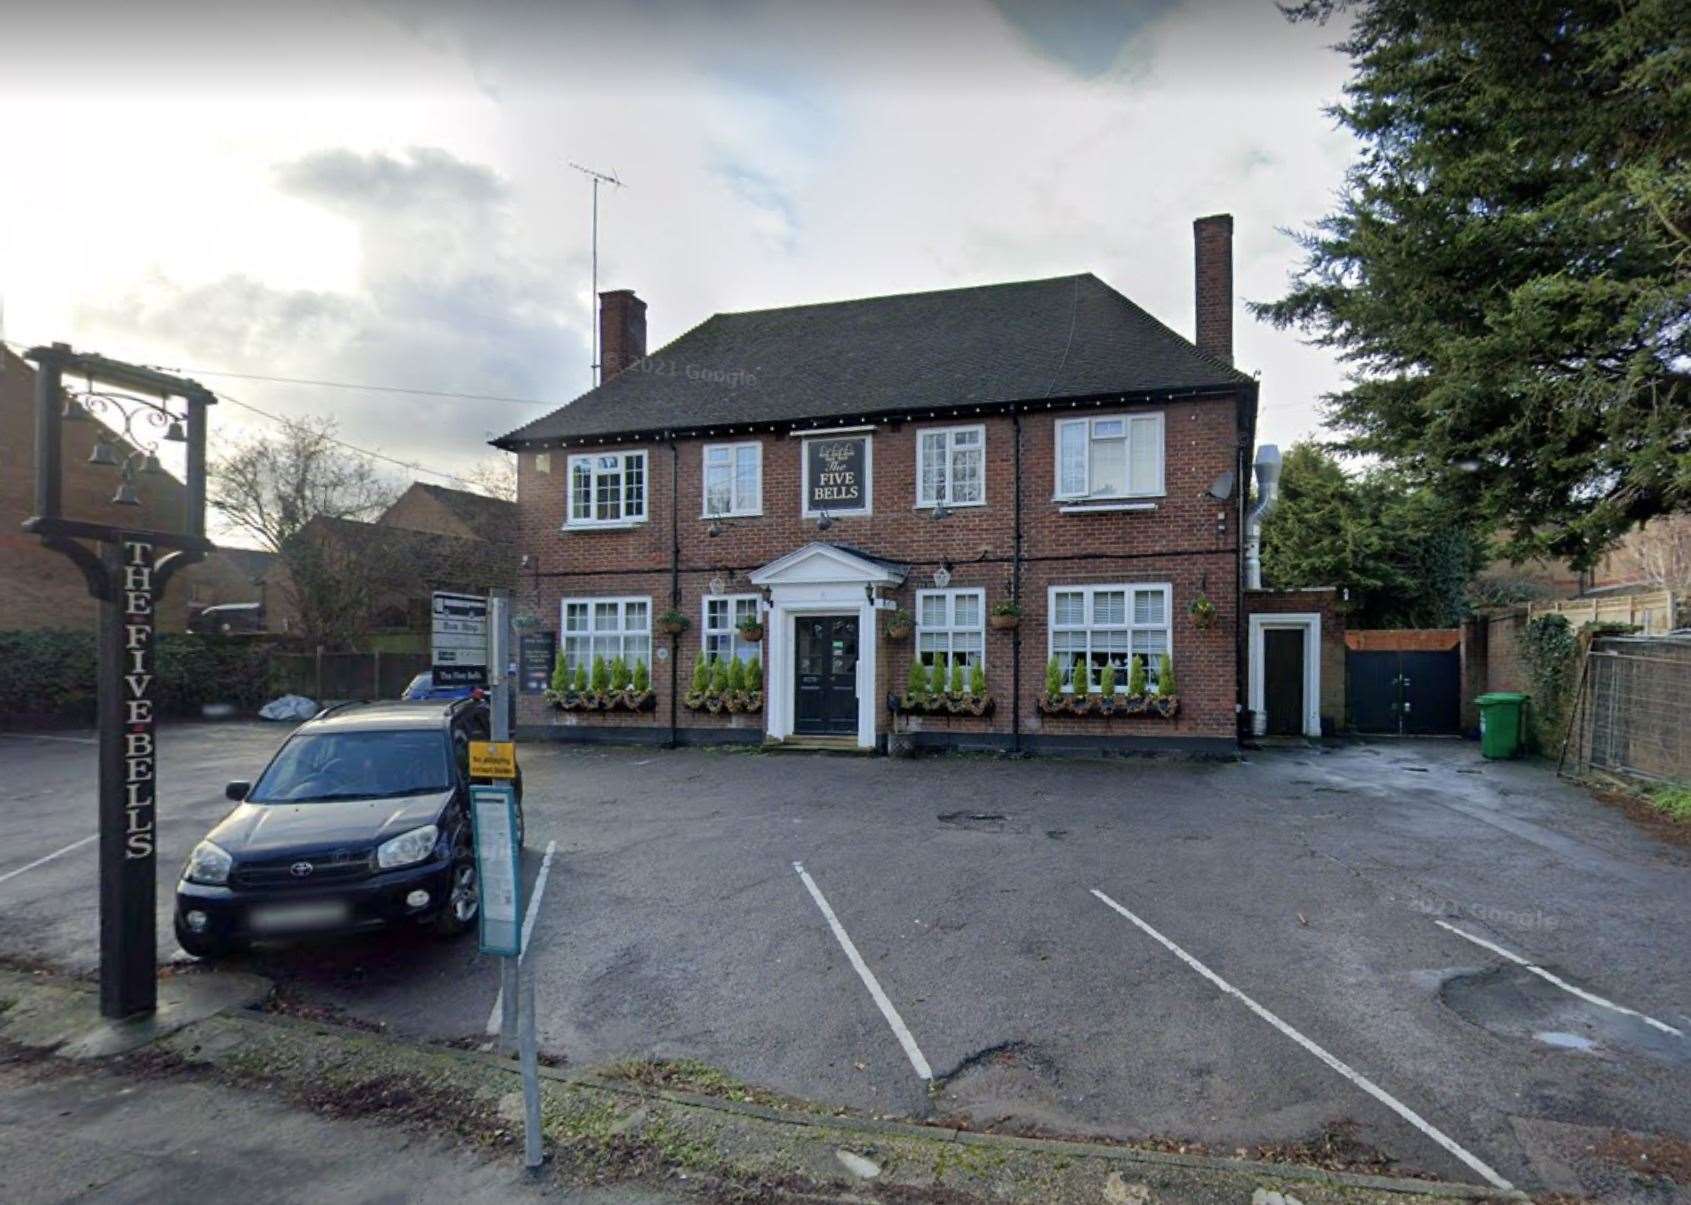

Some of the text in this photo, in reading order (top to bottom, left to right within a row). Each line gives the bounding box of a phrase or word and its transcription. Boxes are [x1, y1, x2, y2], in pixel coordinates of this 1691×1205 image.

[820, 471, 856, 486] FIVE
[814, 485, 859, 500] BELLS
[124, 541, 153, 860] THE FIVE BELLS
